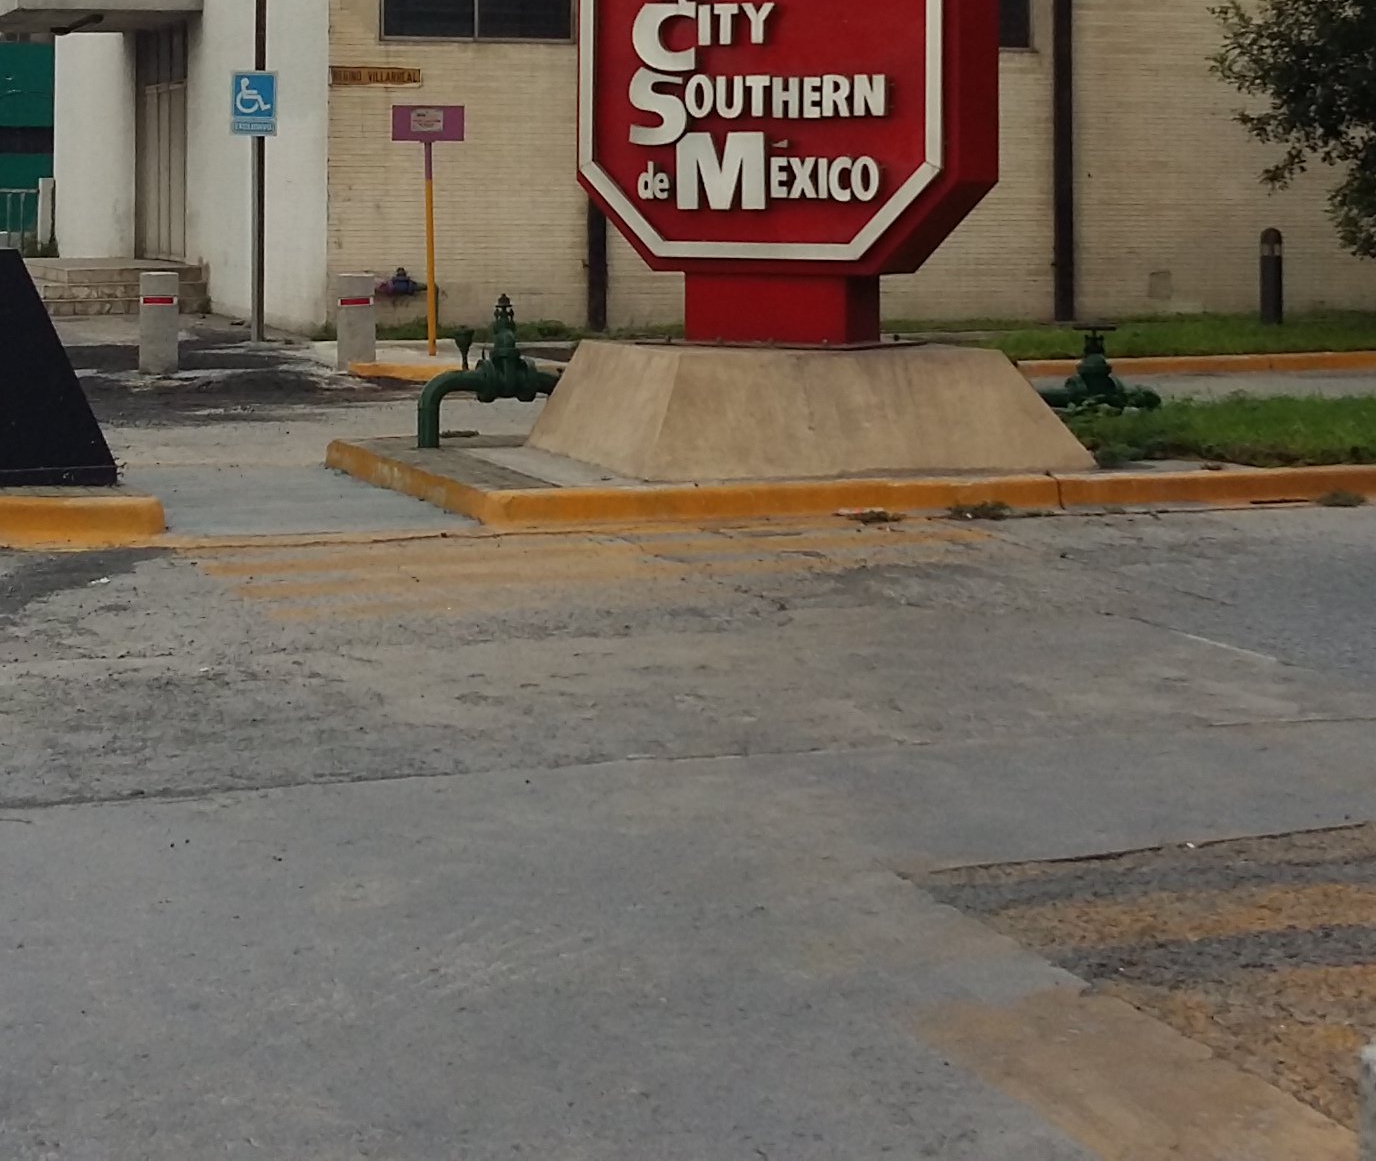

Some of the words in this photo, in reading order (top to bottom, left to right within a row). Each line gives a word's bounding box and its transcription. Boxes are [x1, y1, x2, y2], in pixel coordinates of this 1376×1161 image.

[632, 0, 775, 71] CITY
[629, 67, 886, 146] SOUTHERN
[637, 161, 670, 200] de
